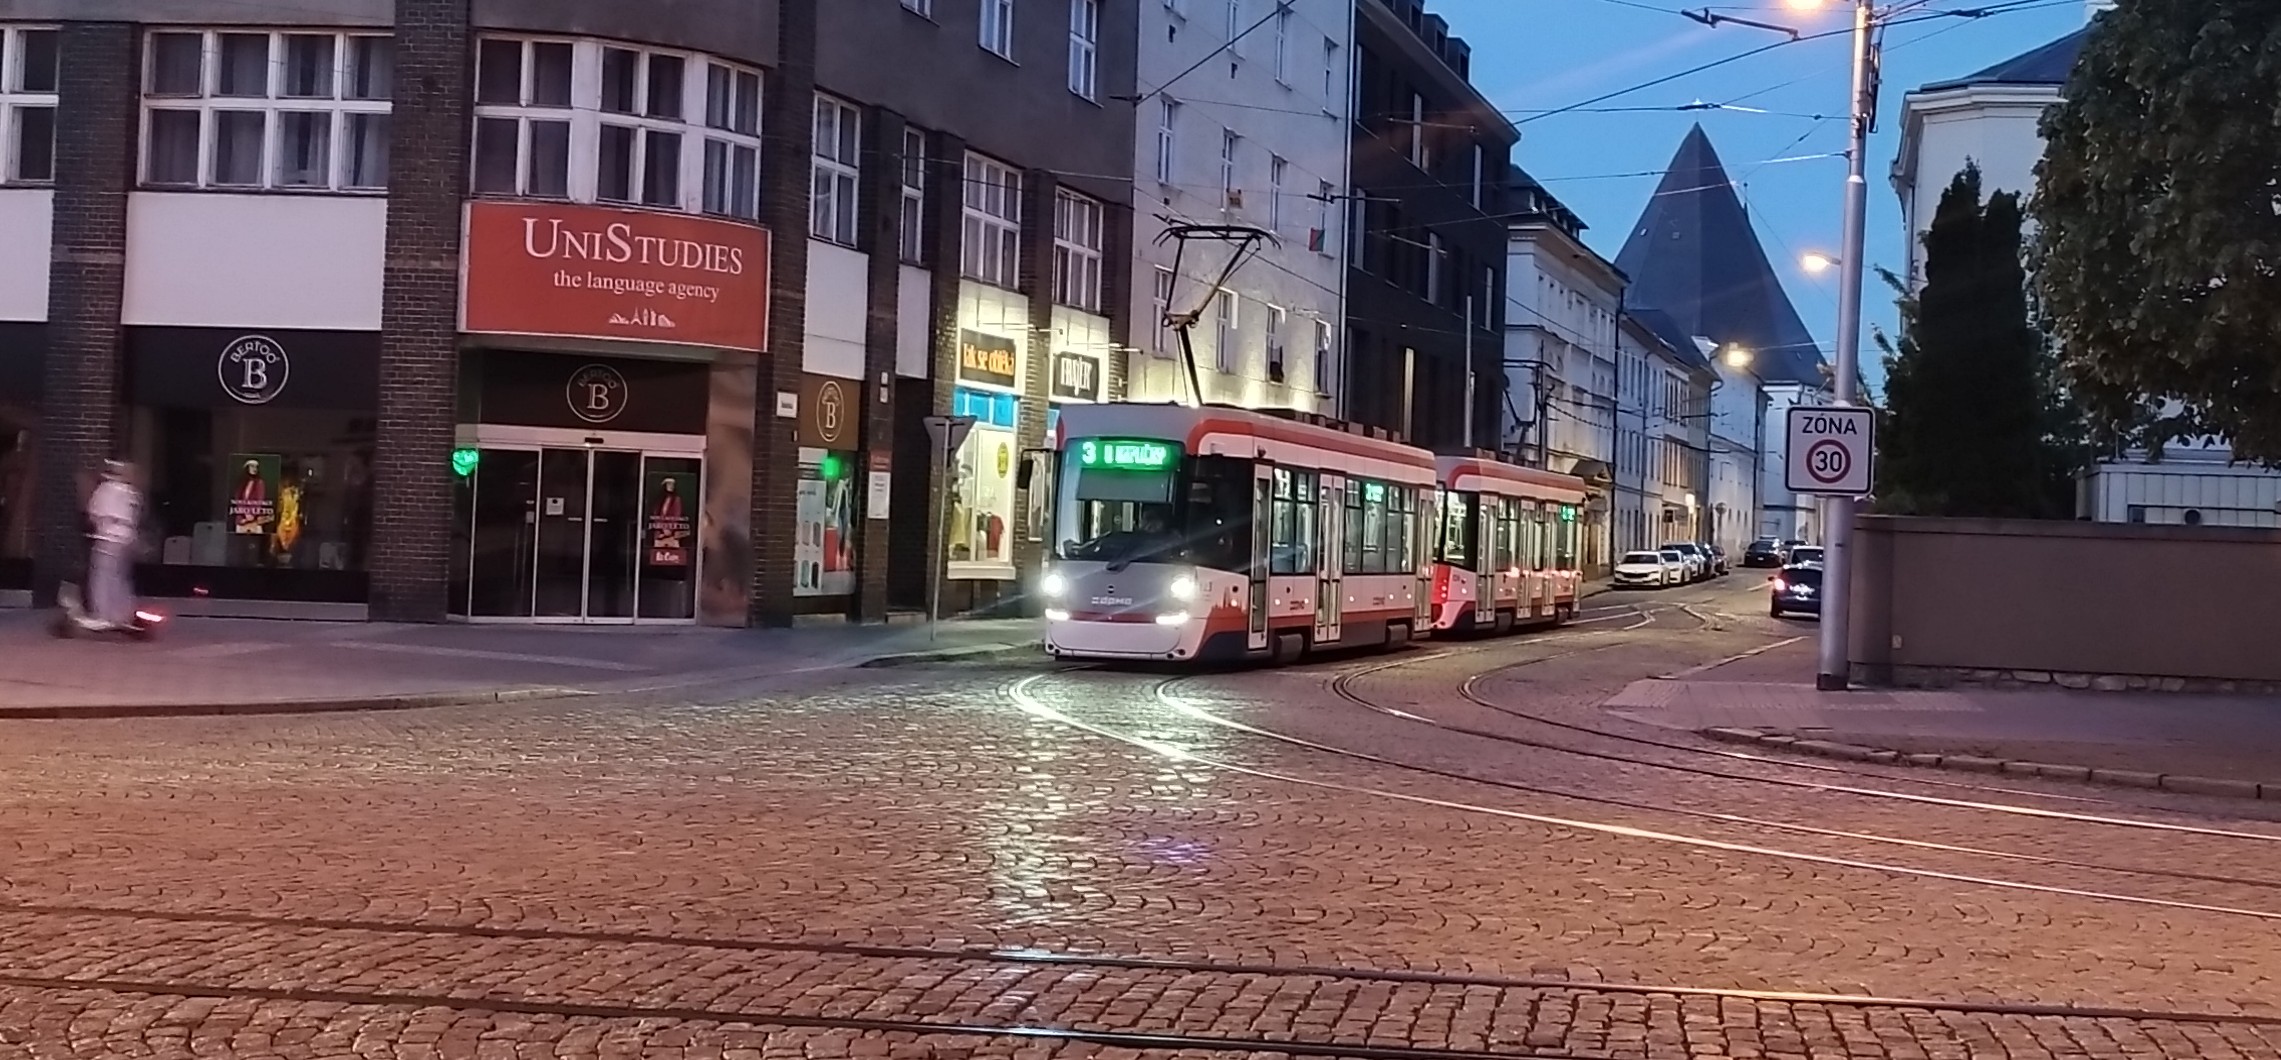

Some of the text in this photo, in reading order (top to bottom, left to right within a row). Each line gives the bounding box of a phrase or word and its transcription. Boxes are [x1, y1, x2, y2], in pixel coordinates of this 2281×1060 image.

[554, 270, 720, 303] the language agency
[241, 358, 267, 389] B
[587, 383, 609, 409] B
[1802, 413, 1857, 435] ZÓNA
[1082, 441, 1097, 464] 3
[1815, 450, 1843, 472] 30
